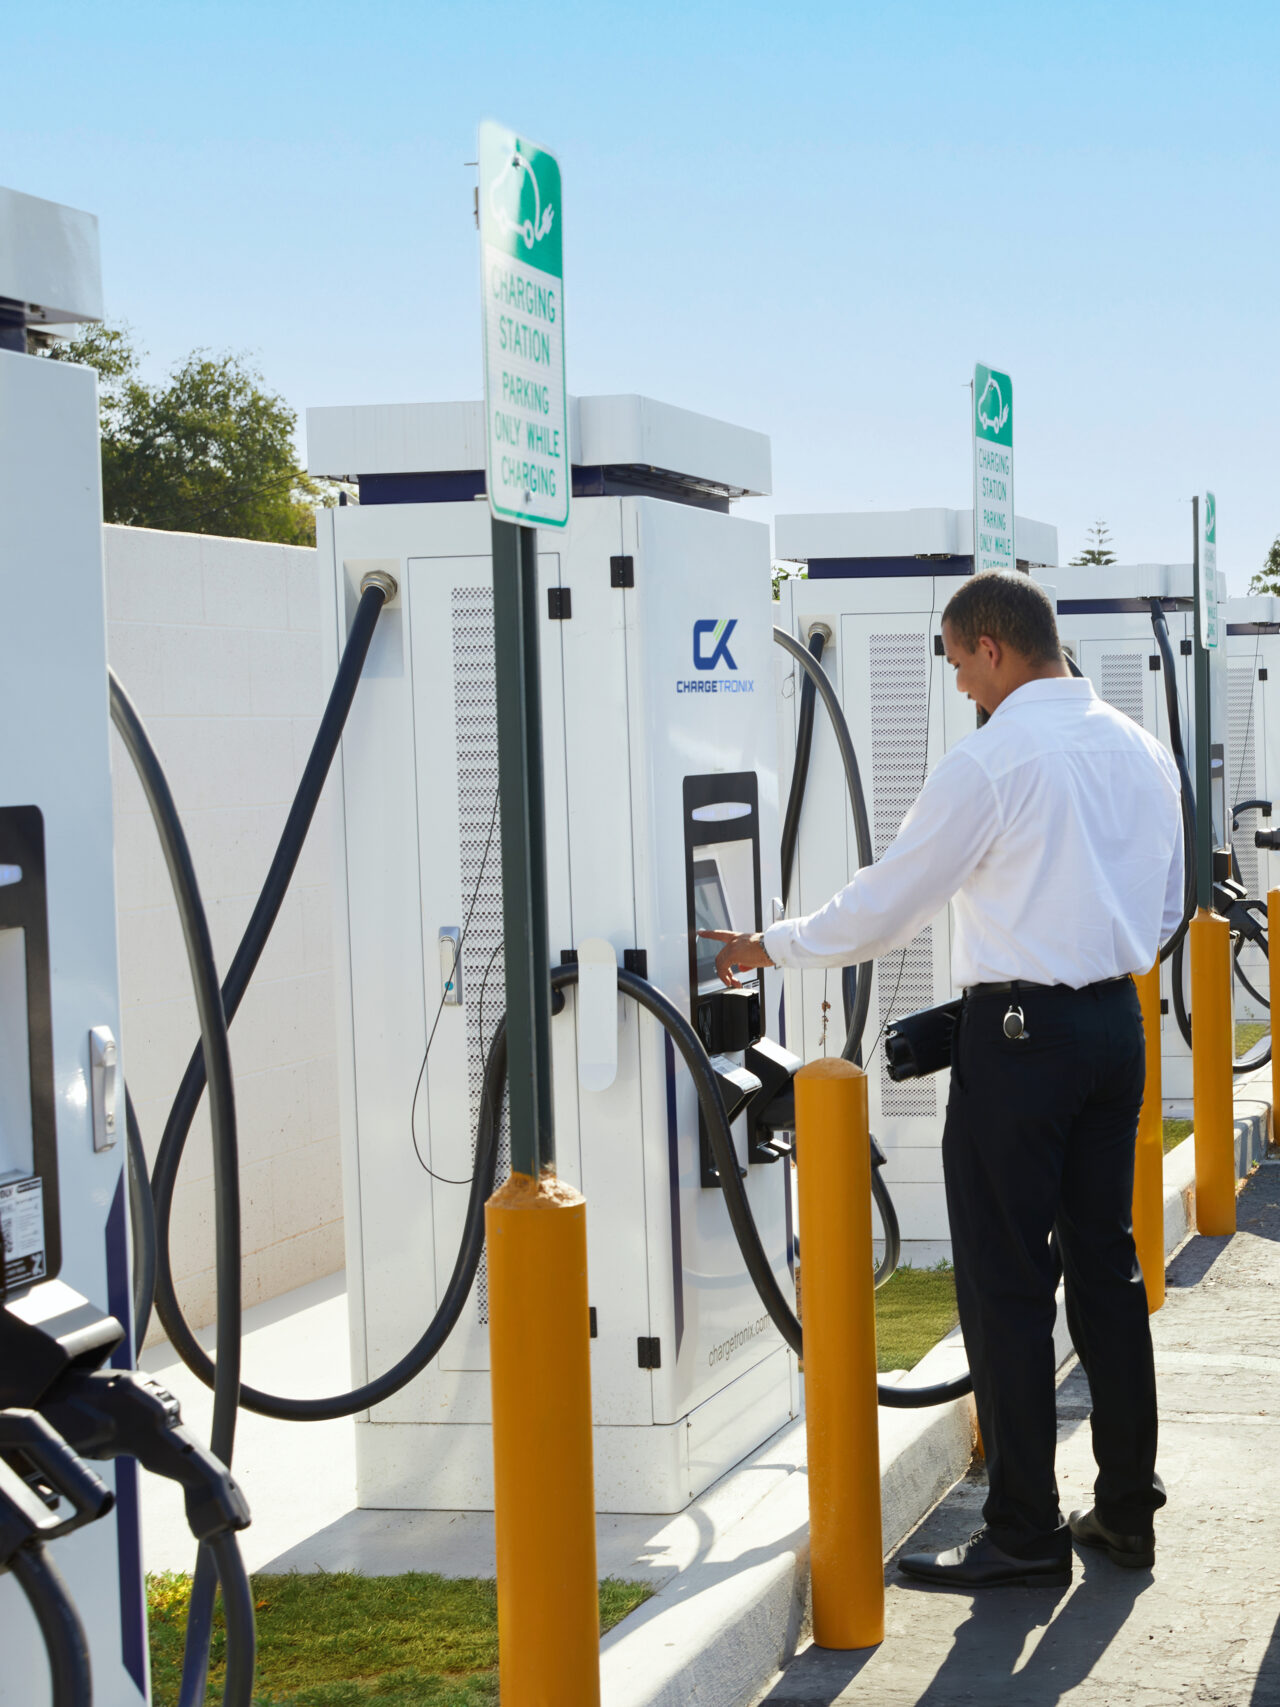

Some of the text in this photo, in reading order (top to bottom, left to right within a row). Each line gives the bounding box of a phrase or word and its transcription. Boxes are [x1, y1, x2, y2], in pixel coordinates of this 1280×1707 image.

[491, 263, 556, 325] CHARGING
[499, 315, 550, 367] STATION
[502, 371, 549, 415] PARKING
[495, 410, 560, 459] ONLY WHILE
[501, 455, 556, 497] CHARGING
[979, 448, 1010, 476] CHARGING
[982, 477, 1007, 502] STATION
[983, 509, 1006, 531] PARKING
[980, 533, 1011, 556] ONLY WHILE
[676, 680, 754, 693] CHARGETRONIX
[708, 1313, 770, 1367] chargetronix.com
